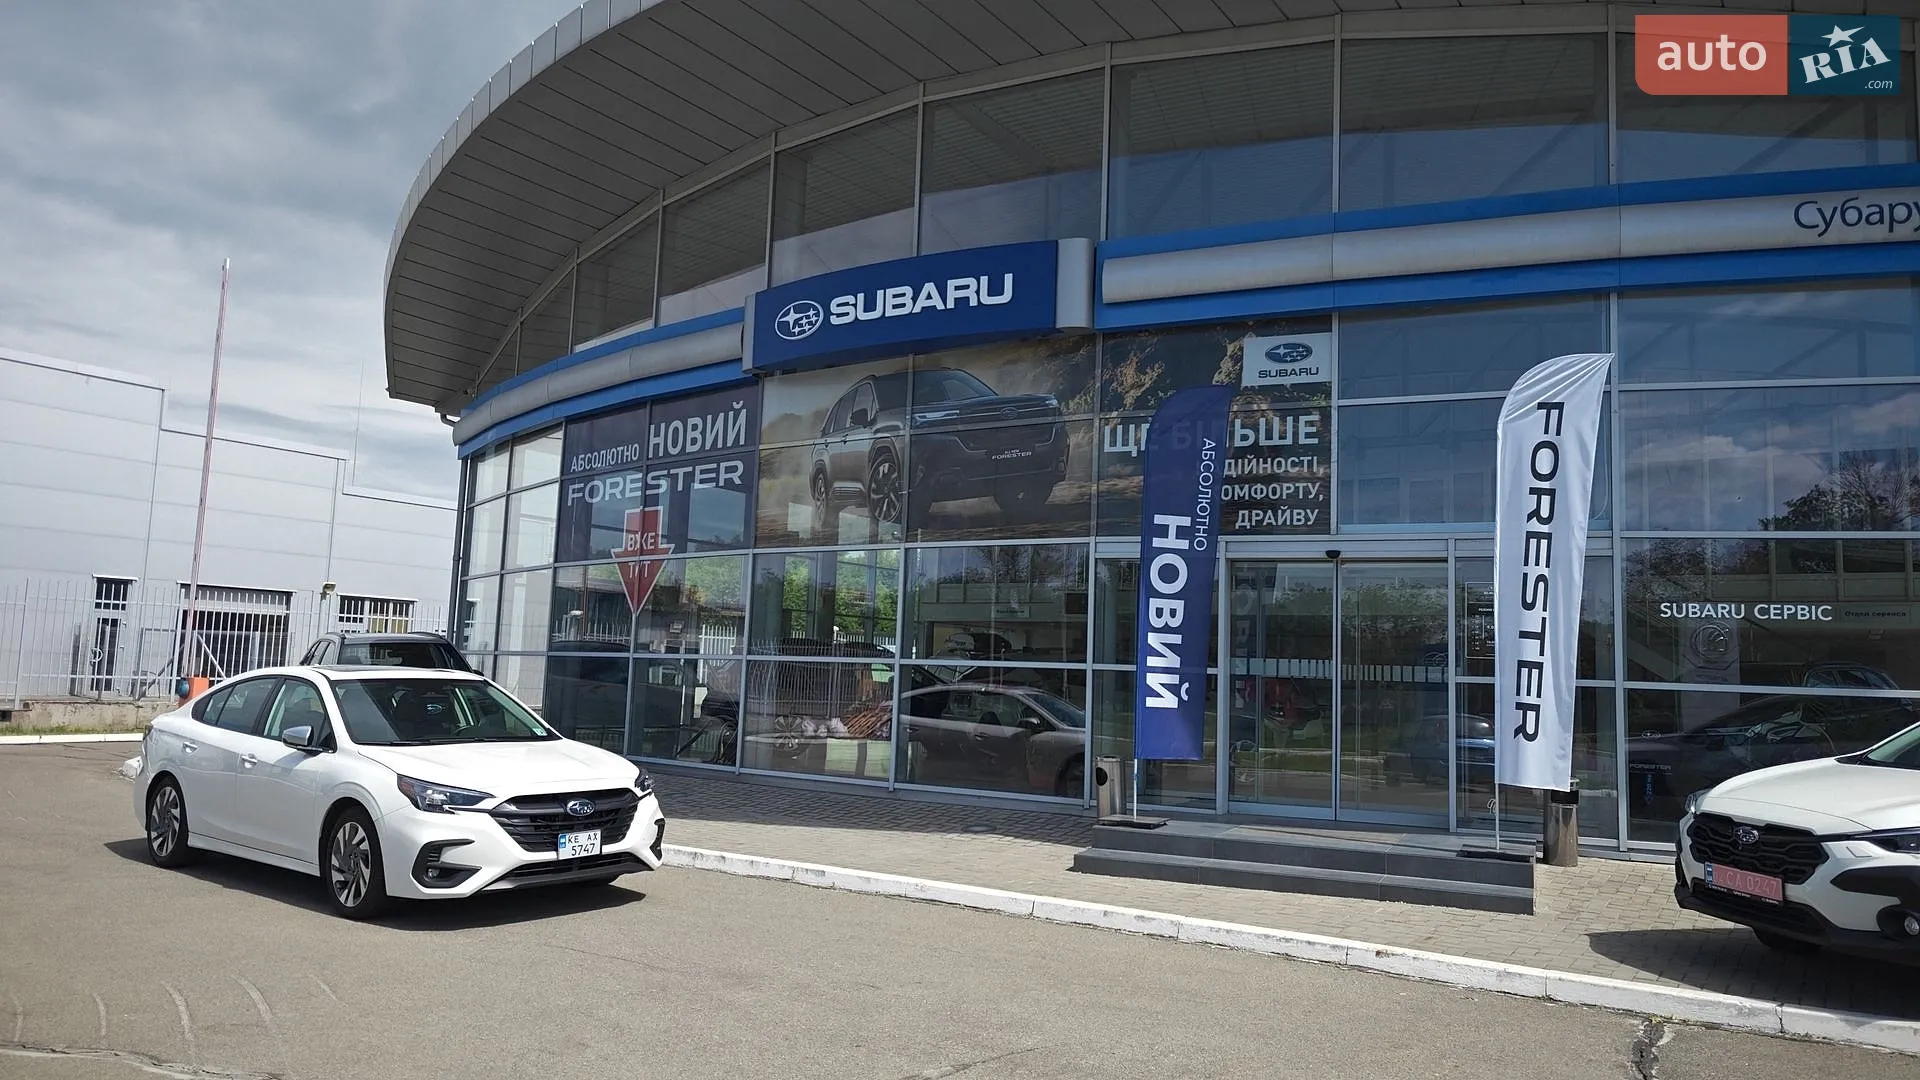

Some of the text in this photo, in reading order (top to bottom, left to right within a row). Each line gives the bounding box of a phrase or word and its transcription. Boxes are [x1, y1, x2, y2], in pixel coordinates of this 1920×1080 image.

[829, 272, 1014, 326] SUBARU
[1258, 366, 1320, 379] SUBARU
[570, 400, 747, 473] АБСОЛЮТНО НОВИЙ
[1222, 455, 1325, 478] ДІЙНОСТІ,
[567, 460, 745, 507] FORESTER
[1193, 437, 1217, 552] АБСОЛЮТНО
[1221, 482, 1325, 502] ОМФОРТУ,
[1235, 506, 1320, 530] ДРАЙВУ
[627, 531, 656, 552] ВЖЕ
[1513, 401, 1565, 744] FORESTER
[1145, 513, 1192, 710] НОВИЙ
[1659, 602, 1833, 621] SUBARU СЕРВІС
[571, 842, 596, 857] 5747
